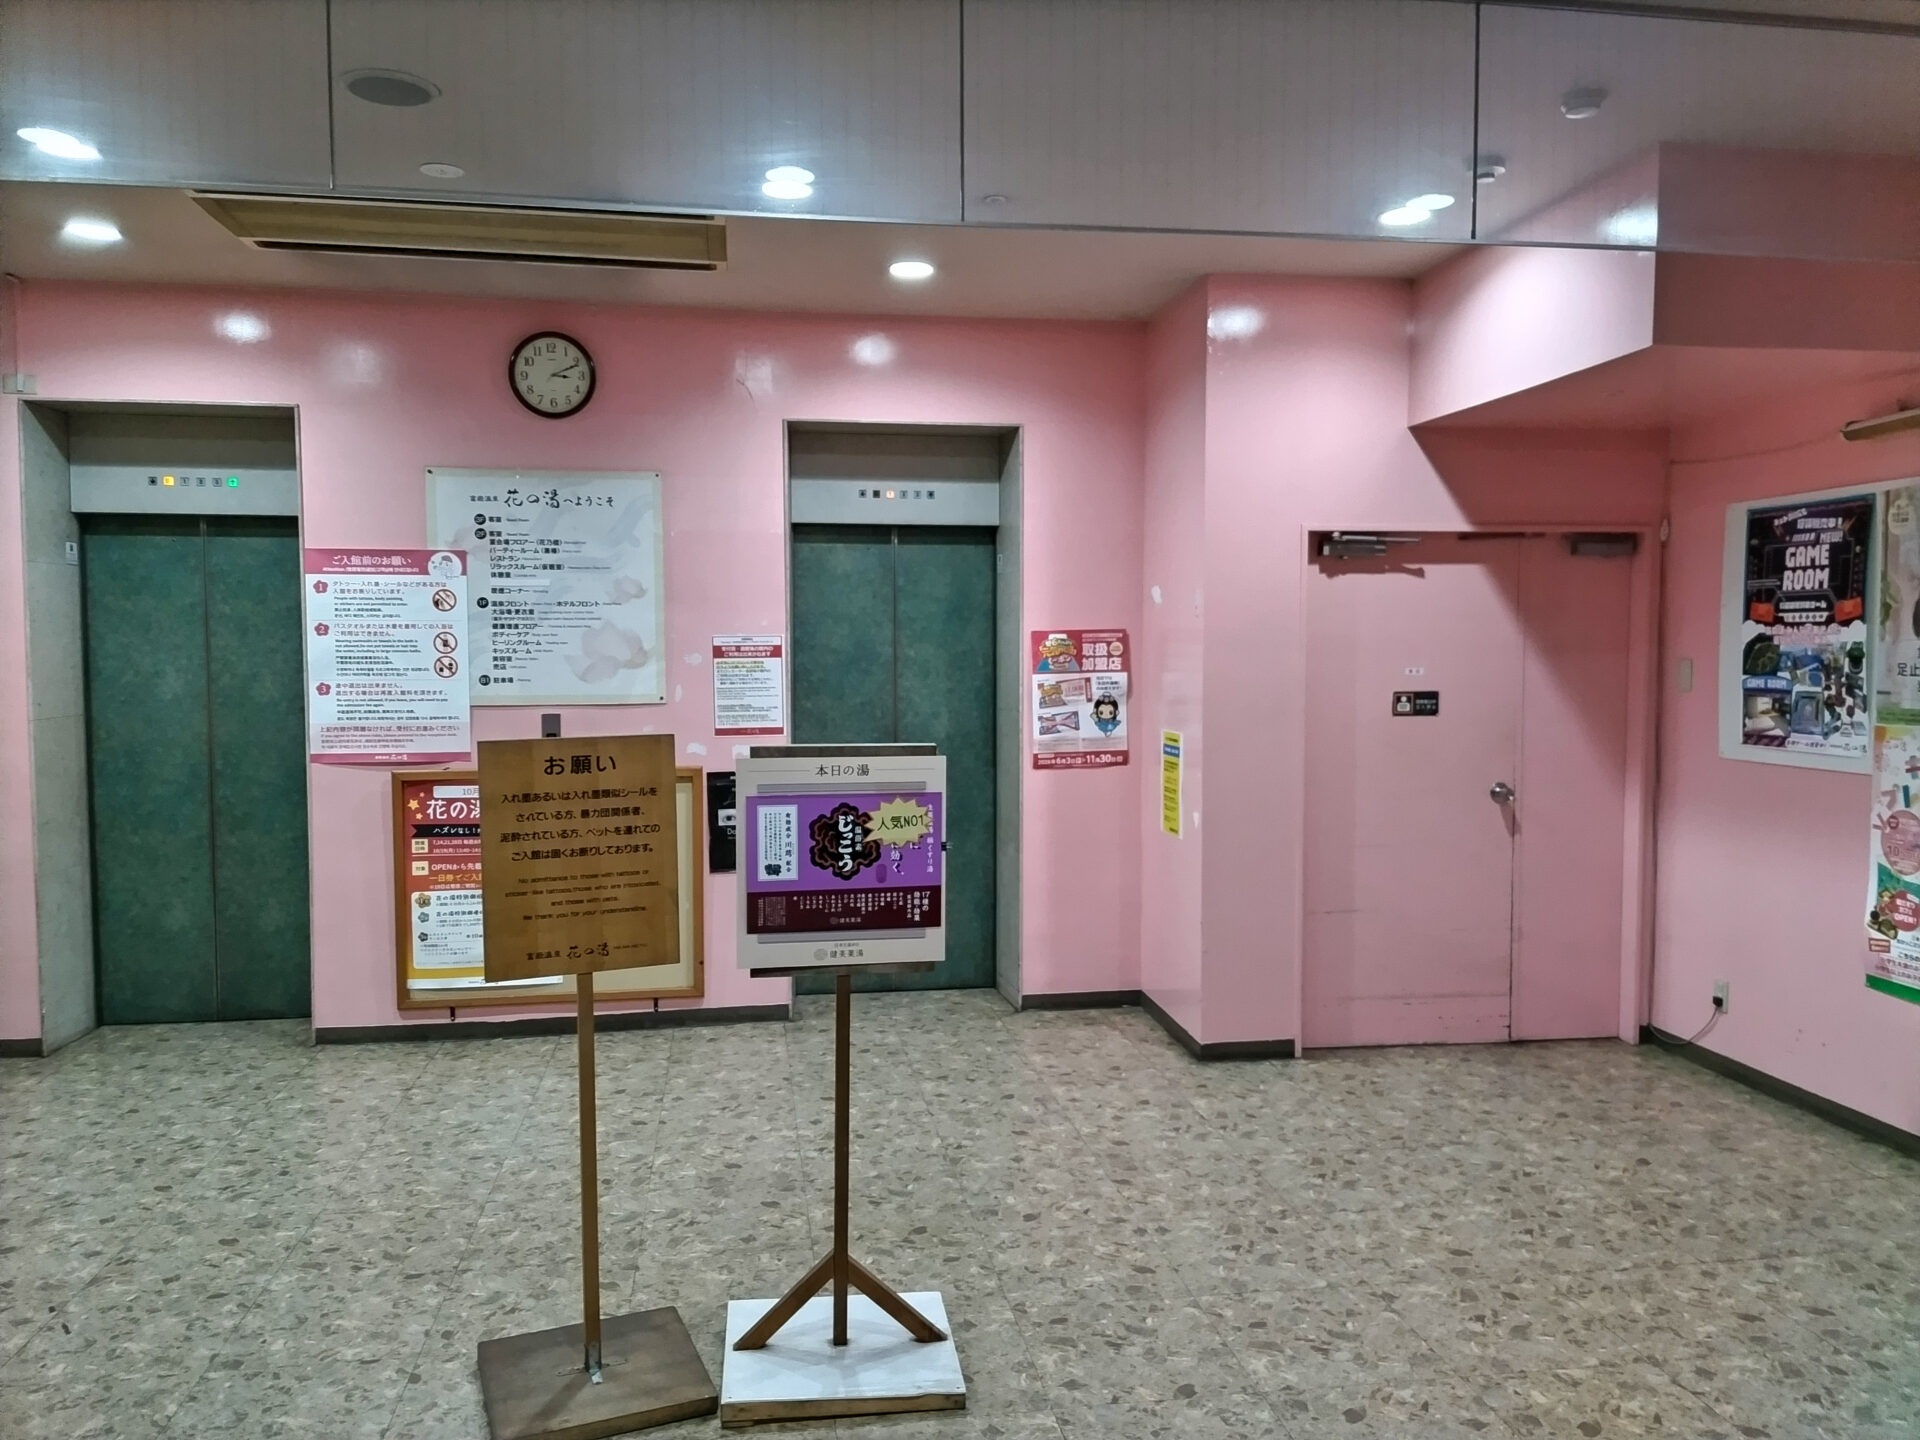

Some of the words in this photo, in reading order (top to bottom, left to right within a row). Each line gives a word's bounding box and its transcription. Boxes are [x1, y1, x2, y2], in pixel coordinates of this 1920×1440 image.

[533, 346, 542, 357] 11
[546, 342, 557, 354] 12
[564, 346, 568, 357] 1
[524, 356, 535, 367] 10
[520, 370, 529, 381] 9
[578, 370, 585, 381] 3
[526, 385, 535, 395] 8
[574, 384, 580, 394] 4
[537, 394, 544, 405] 7
[550, 397, 558, 408] 6
[564, 395, 572, 405] 5
[504, 488, 614, 509] 花の湯へようこそ
[332, 555, 411, 566] ご入館前のお願い
[1785, 544, 1830, 568] GAME
[1782, 568, 1829, 591] ROOM
[1082, 643, 1108, 656] 取扱
[1747, 680, 1765, 688] GAME
[544, 755, 617, 776] お願い
[815, 764, 870, 777] 本日の湯
[501, 787, 658, 804] 入れ墨あるいは入れ墨類似シールを
[877, 814, 924, 831] 人気NO1
[500, 824, 661, 843] 泥酔されている方、ペットを連れての
[838, 815, 854, 872] じっこう
[511, 843, 653, 862] ご入館は固くお断りしております。
[566, 942, 610, 960] 花の湯
